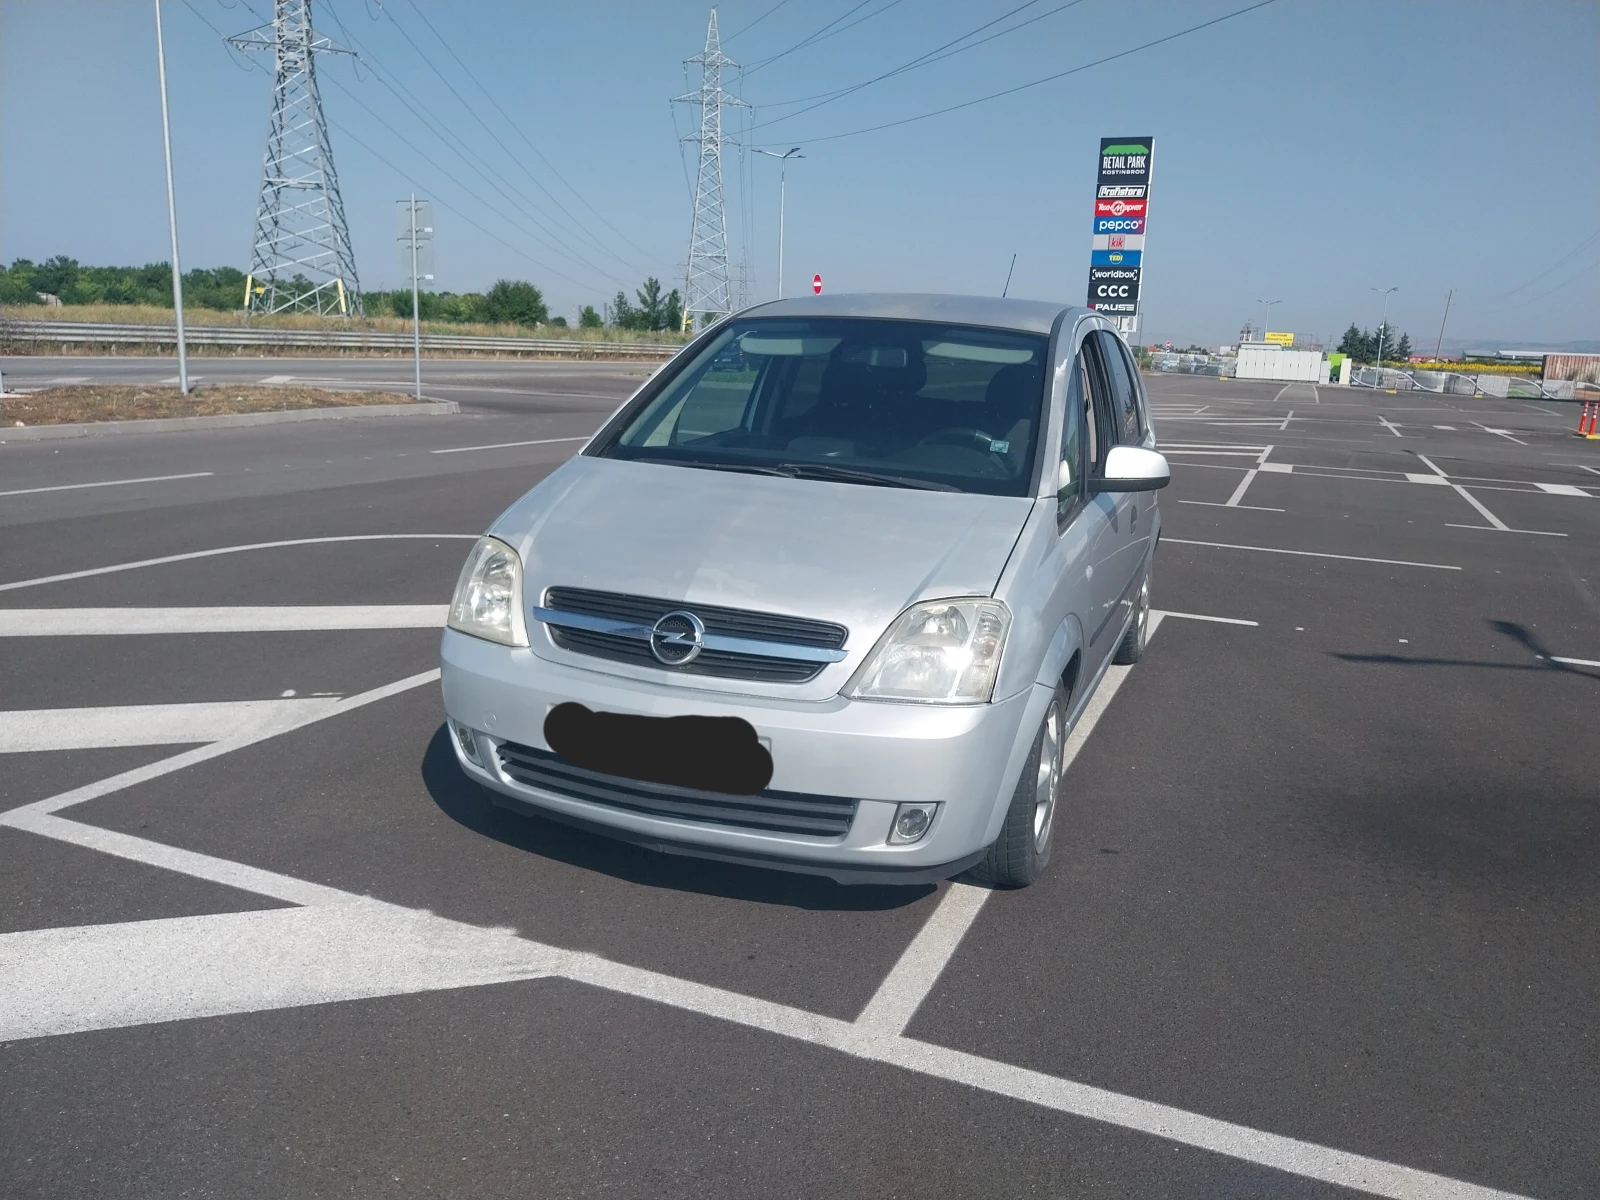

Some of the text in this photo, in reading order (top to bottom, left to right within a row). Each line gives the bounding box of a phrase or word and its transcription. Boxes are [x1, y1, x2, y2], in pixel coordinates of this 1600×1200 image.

[1102, 155, 1146, 169] RETAIL PARK
[1099, 220, 1139, 231] pepco
[1097, 285, 1129, 297] CCC
[1095, 303, 1135, 311] PAUSE
